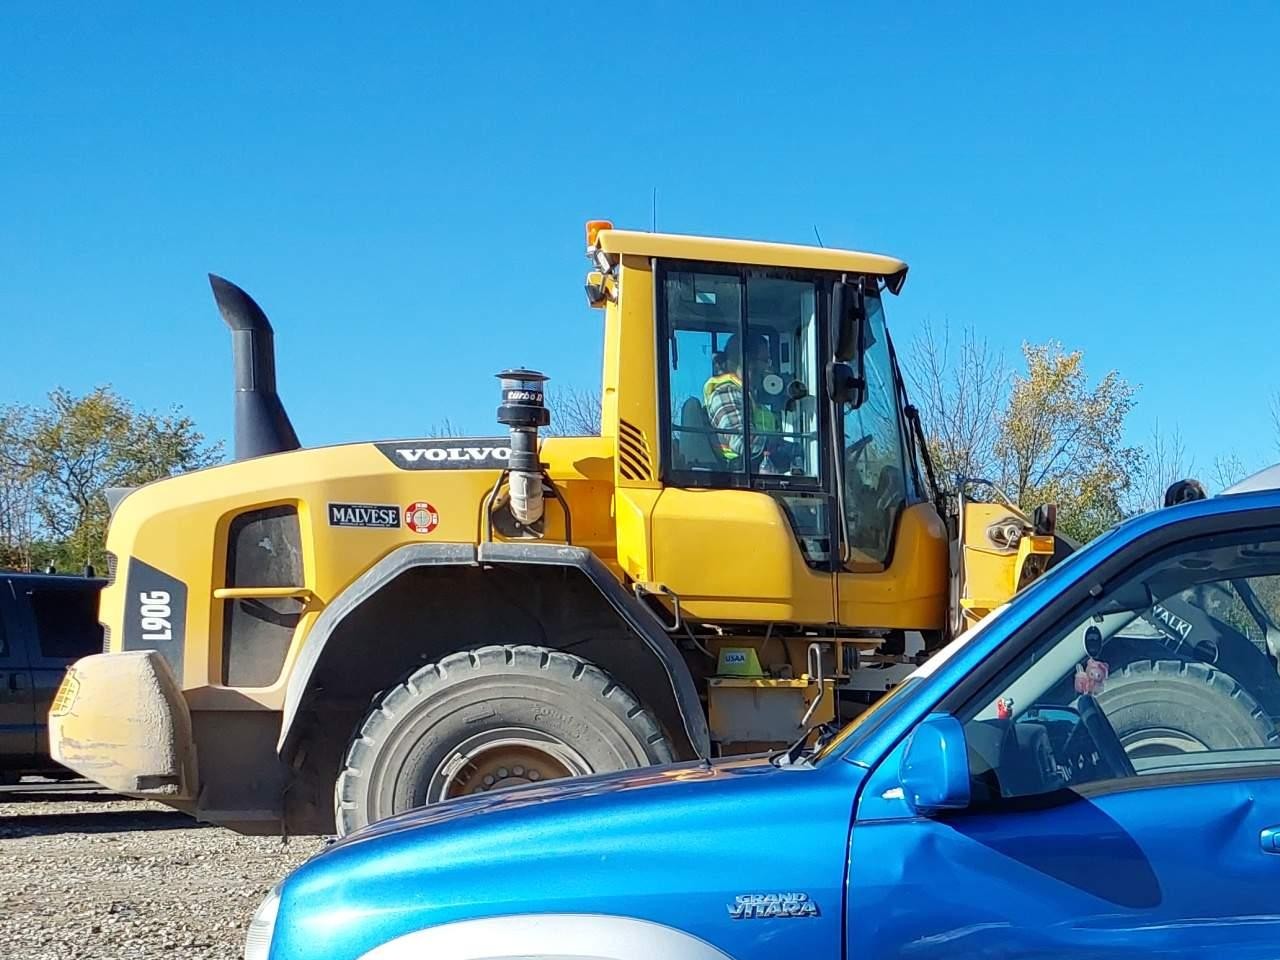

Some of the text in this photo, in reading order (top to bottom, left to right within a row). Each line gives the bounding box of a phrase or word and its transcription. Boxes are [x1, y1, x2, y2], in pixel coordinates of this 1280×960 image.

[507, 390, 536, 401] turbo
[396, 447, 514, 462] VOLVO
[332, 507, 398, 525] MALVESE
[140, 590, 173, 641] L90G
[725, 654, 745, 662] USAA
[735, 892, 808, 904] GRAND
[726, 901, 819, 918] VITARA
